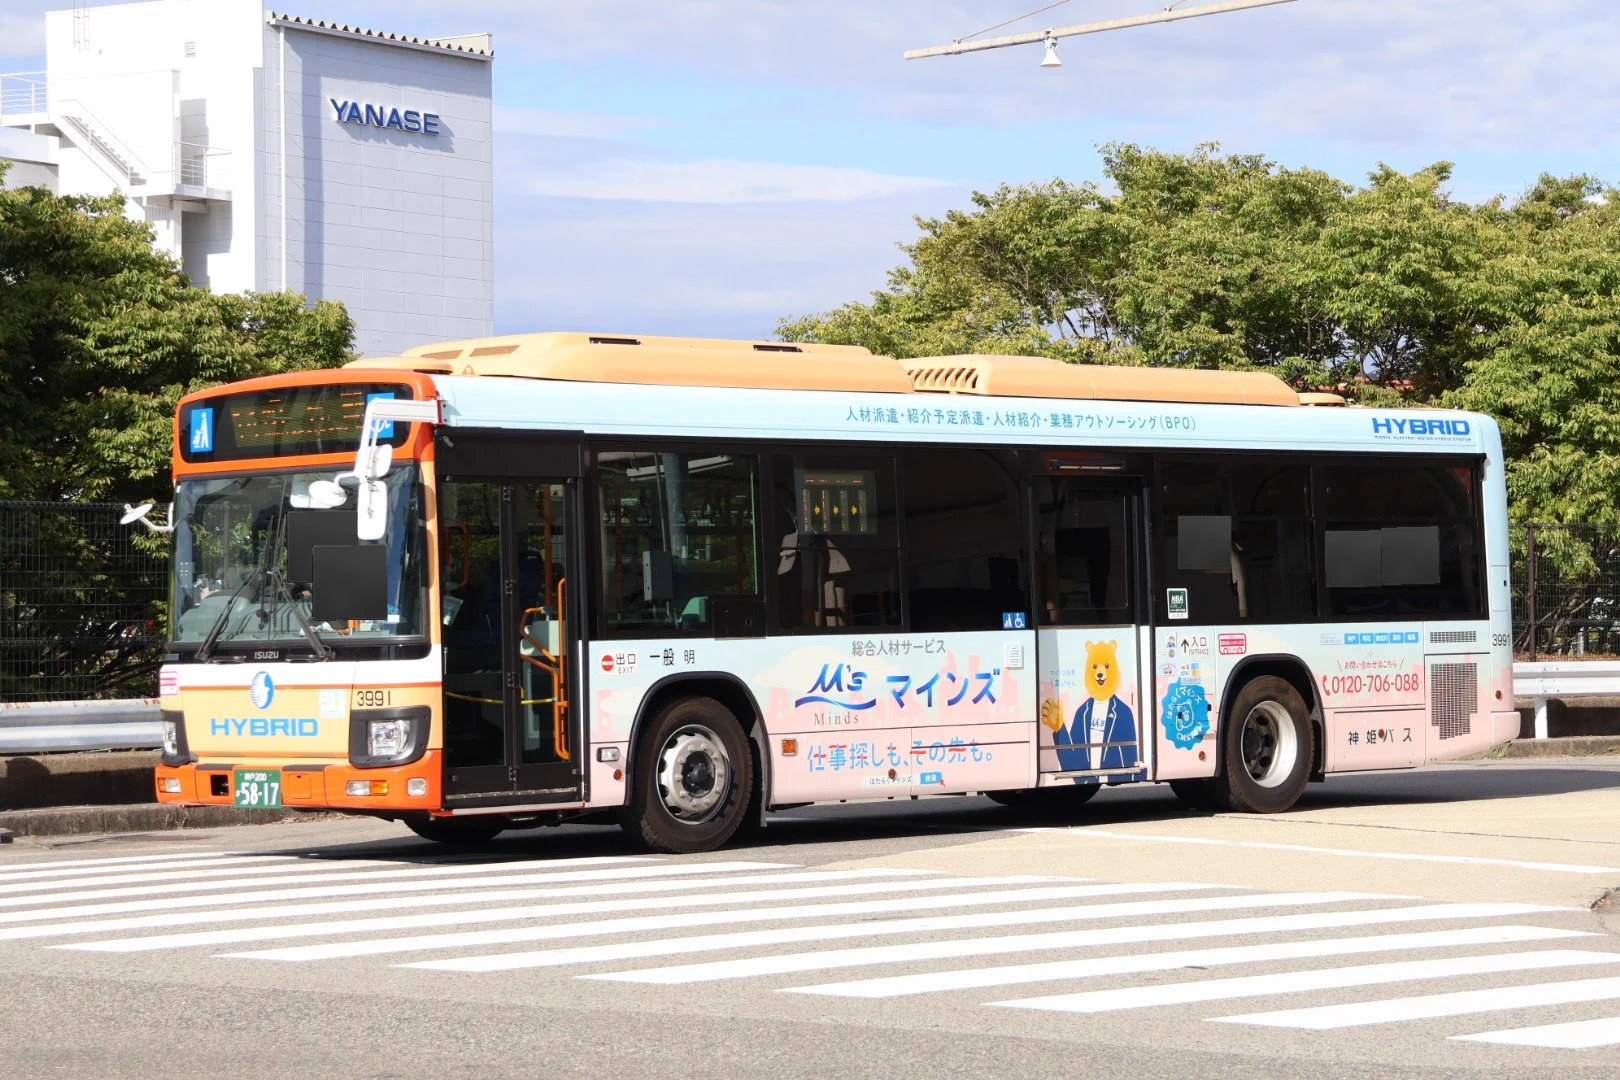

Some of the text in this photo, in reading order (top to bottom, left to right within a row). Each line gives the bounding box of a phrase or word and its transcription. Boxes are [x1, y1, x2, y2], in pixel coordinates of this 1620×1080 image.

[329, 98, 440, 136] YANASE
[1371, 417, 1471, 436] HYBRID
[851, 639, 947, 657] 総合人材サービス
[1191, 636, 1207, 647] 入口
[1492, 633, 1511, 647] 3991
[254, 650, 279, 660] ISUZU
[615, 653, 636, 666] 出口
[649, 648, 695, 666] 一般 明
[1188, 648, 1210, 656] ENTRANCE
[618, 666, 634, 674] EXIT
[1344, 660, 1398, 670] お問い合わせはこちら
[886, 668, 1001, 709] マインズ
[1331, 673, 1419, 694] 0120-706-088
[356, 690, 391, 707] 3991
[210, 717, 319, 737] HYBRID
[814, 711, 859, 726] Minds
[1347, 727, 1413, 746] 神姫バス
[240, 782, 280, 805] 58-17
